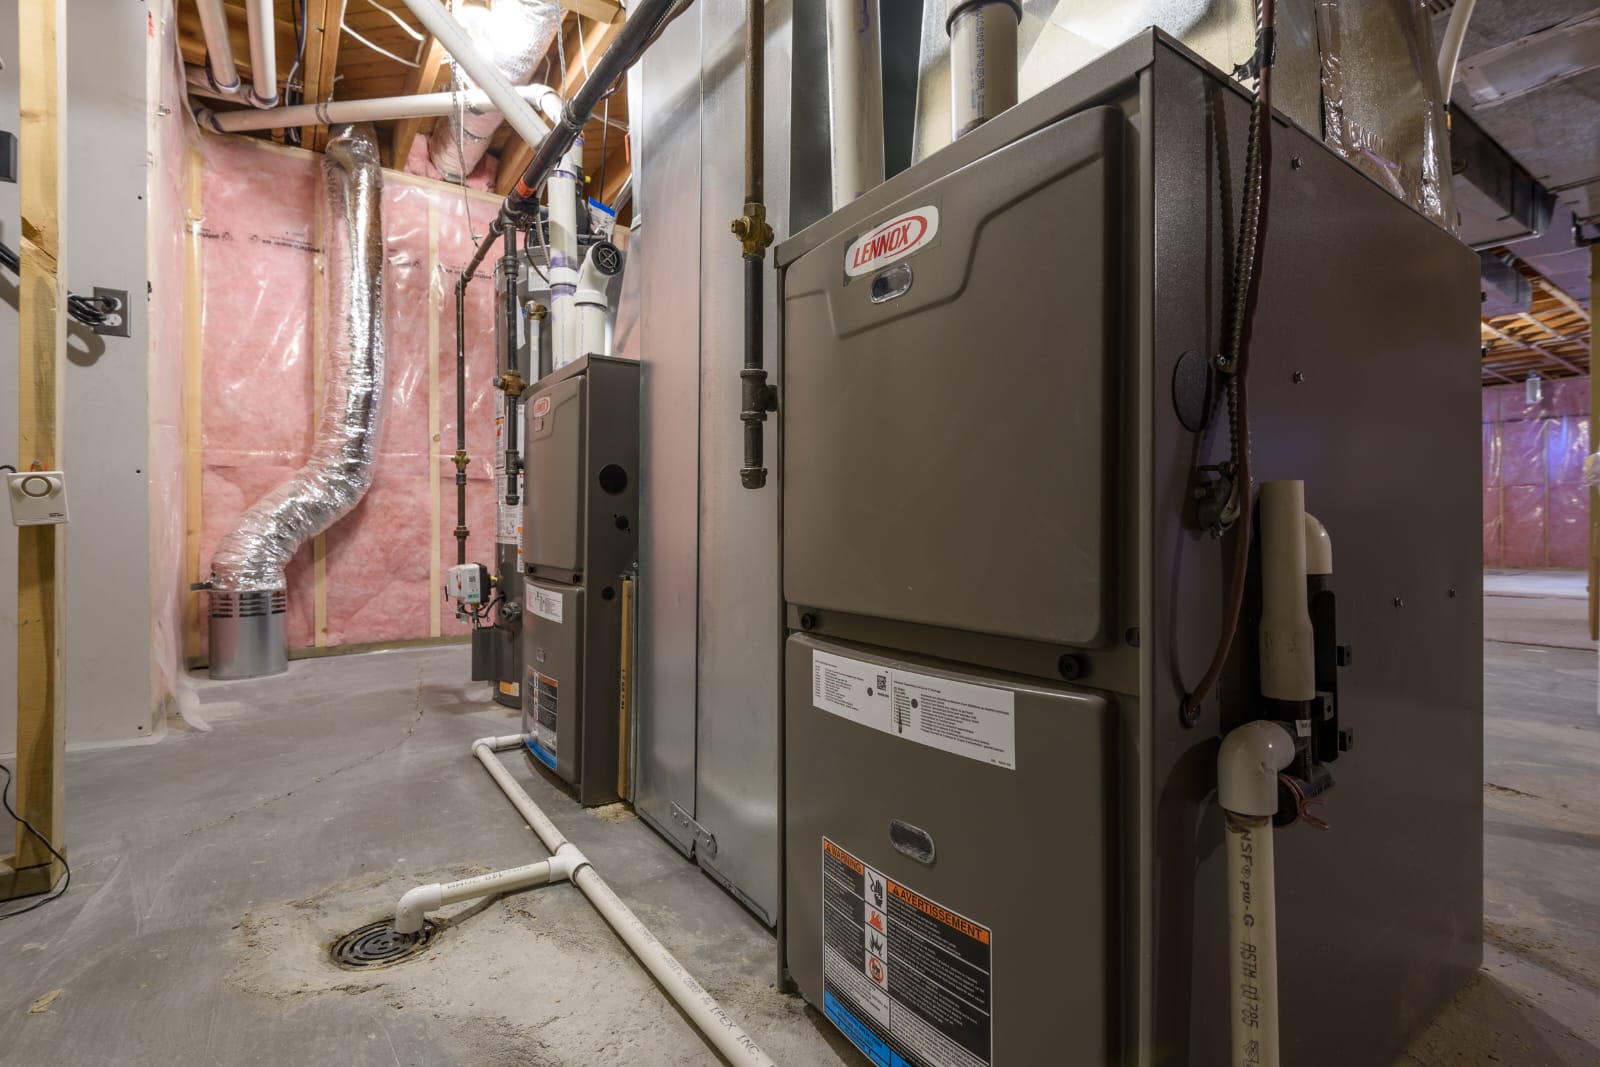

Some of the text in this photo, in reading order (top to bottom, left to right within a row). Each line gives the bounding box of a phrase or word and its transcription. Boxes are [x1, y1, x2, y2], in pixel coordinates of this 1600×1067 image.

[853, 222, 911, 269] LENNOX
[831, 846, 862, 874] WARNING
[901, 890, 982, 939] AVERTISSEMENT
[710, 1006, 737, 1032] IPEX
